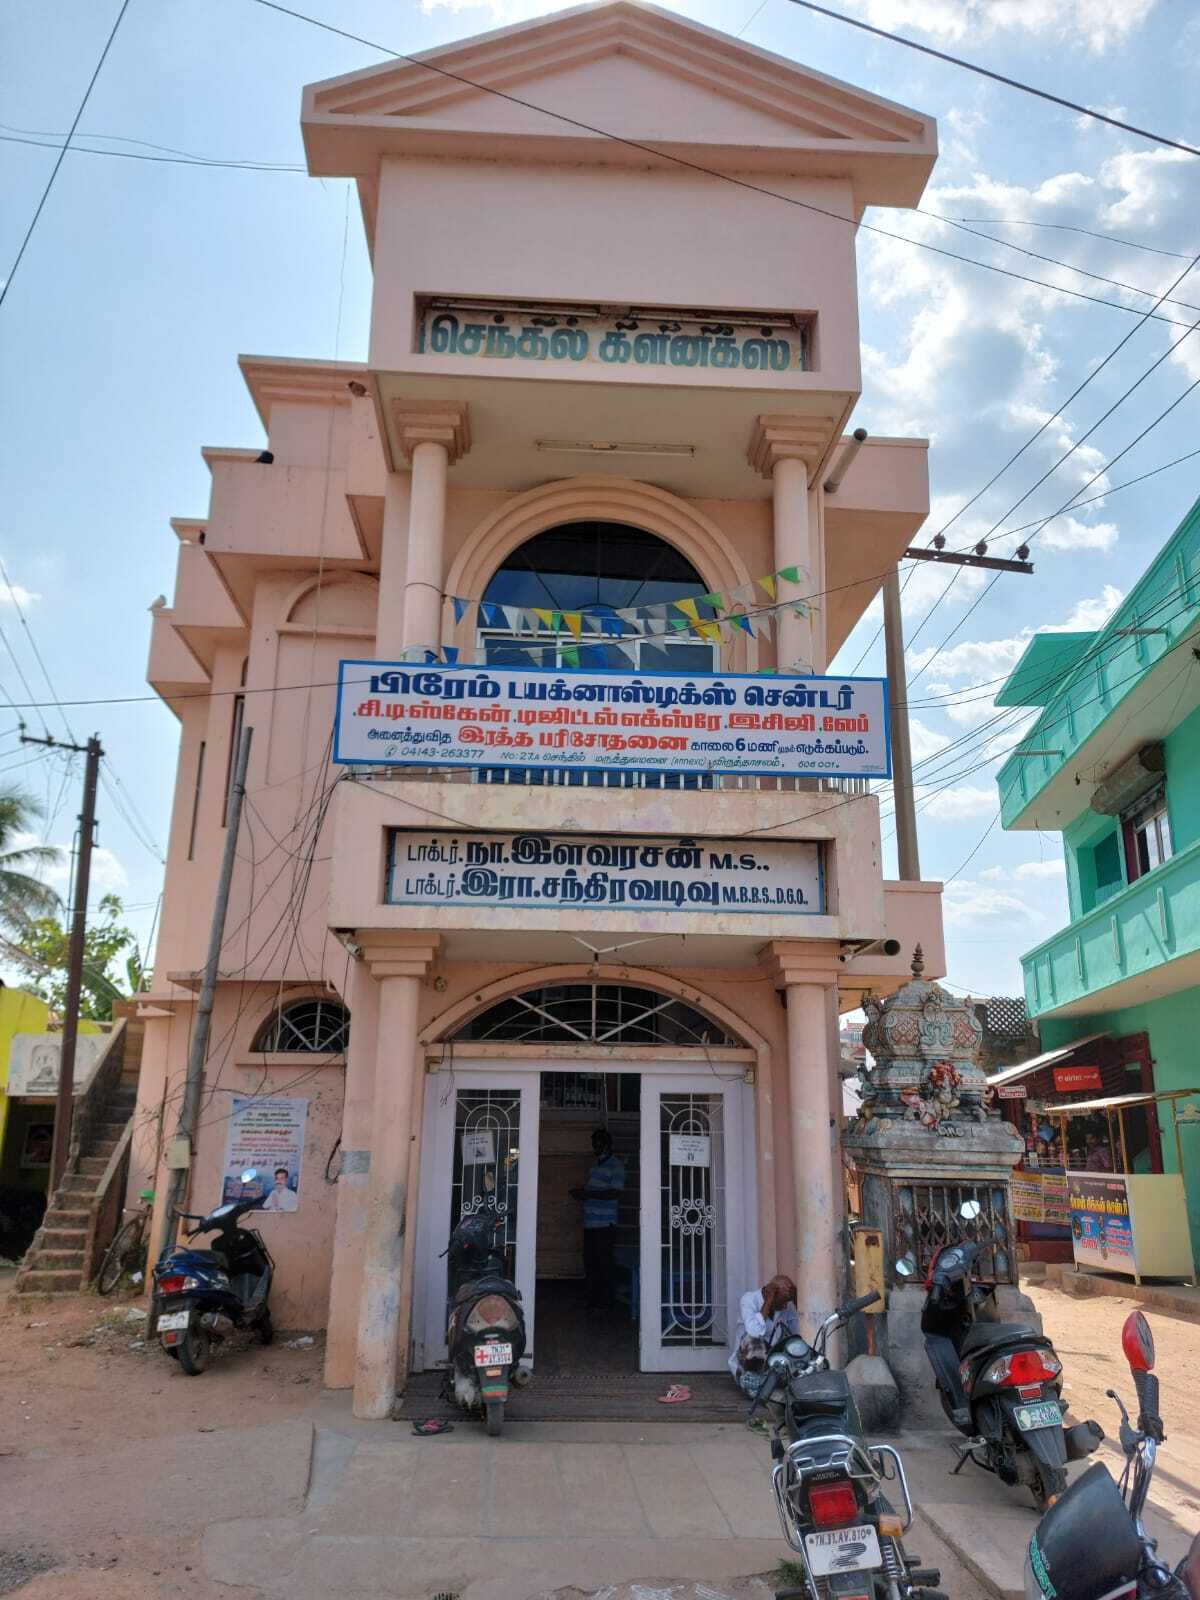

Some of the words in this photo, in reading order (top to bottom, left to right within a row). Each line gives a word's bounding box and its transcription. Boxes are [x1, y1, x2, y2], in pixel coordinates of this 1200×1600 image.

[369, 671, 501, 700] பிரேம்
[743, 684, 855, 710] சென்டர்
[367, 726, 452, 746] அனைத்துவித
[457, 726, 533, 747] இரத்த
[538, 730, 689, 751] பரிசோதனை
[690, 739, 734, 752] காலை
[735, 737, 746, 752] 6
[748, 740, 779, 754] மணி
[400, 746, 485, 759] 04143-263377
[542, 751, 587, 762] செந்தில்
